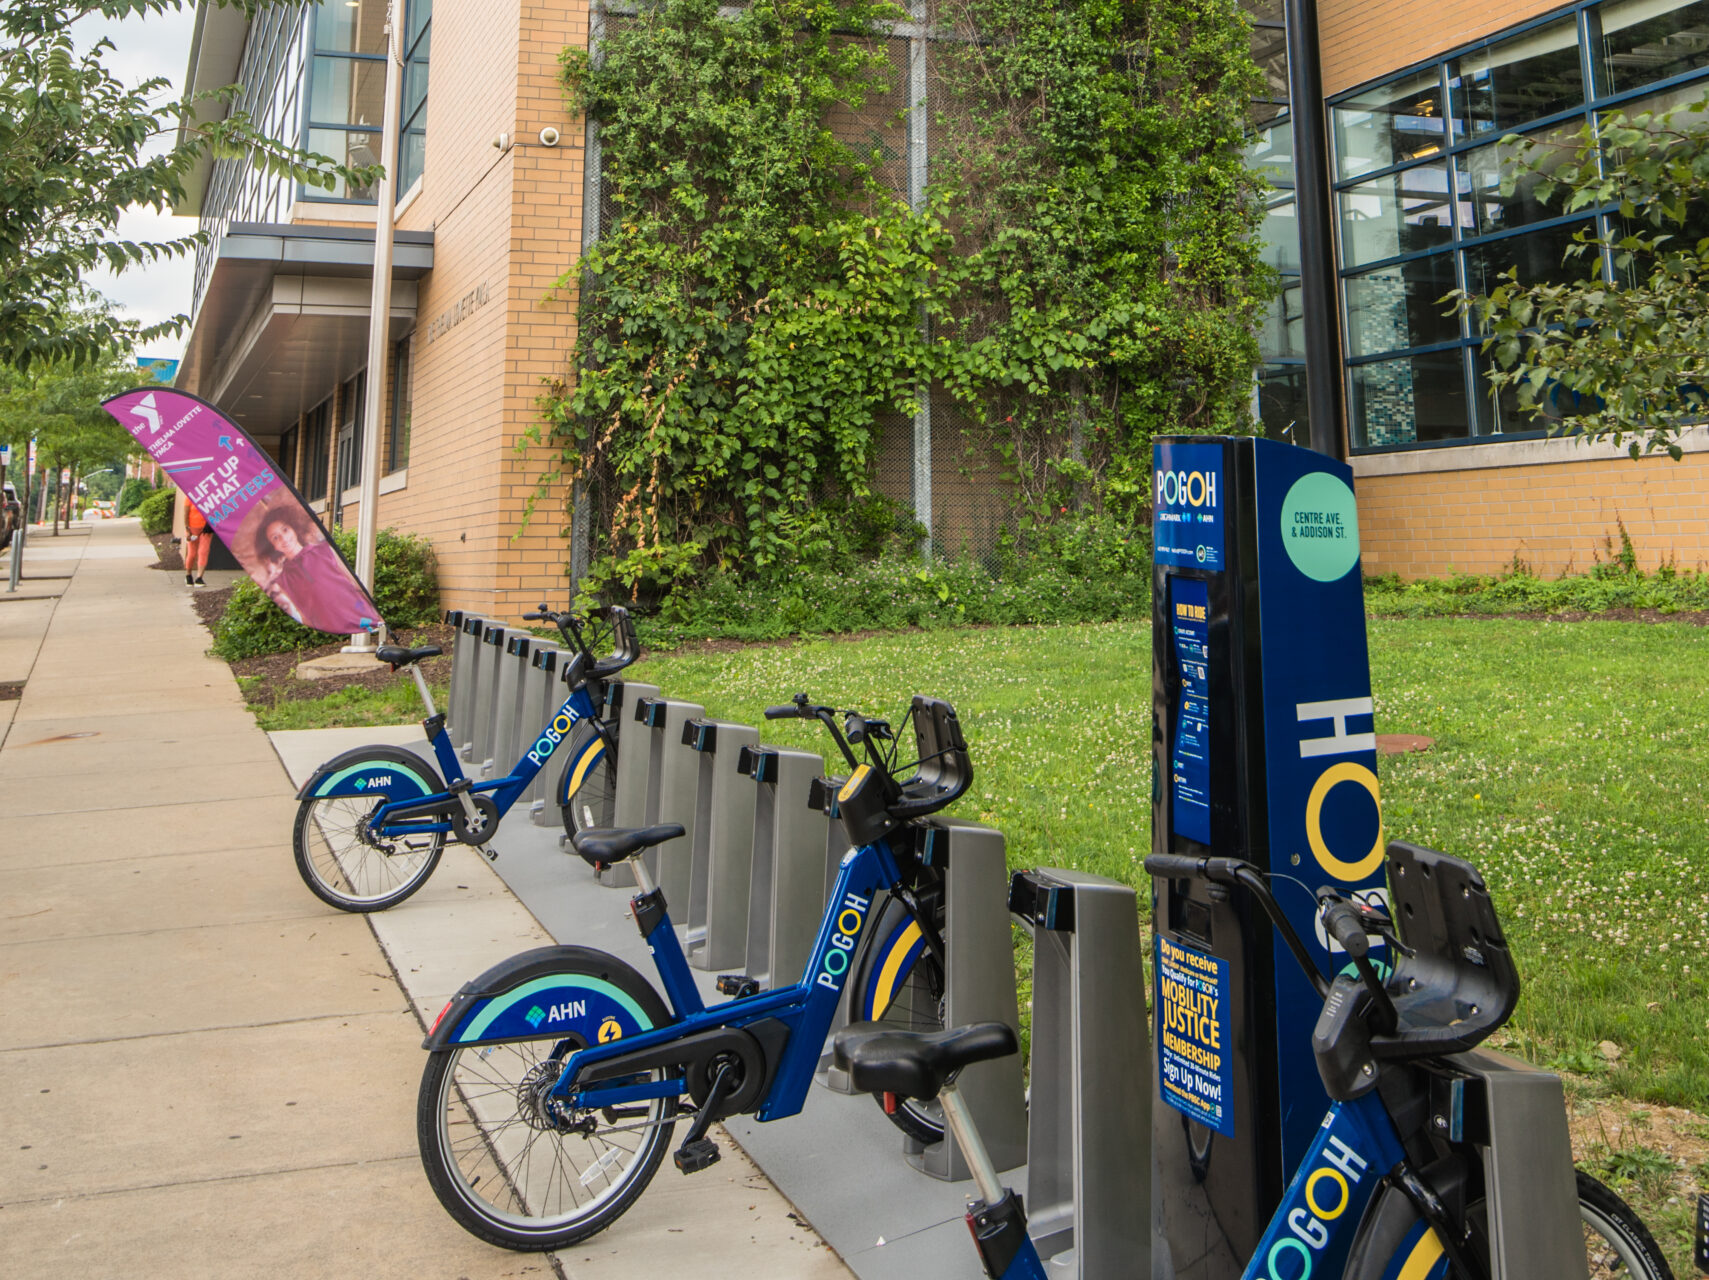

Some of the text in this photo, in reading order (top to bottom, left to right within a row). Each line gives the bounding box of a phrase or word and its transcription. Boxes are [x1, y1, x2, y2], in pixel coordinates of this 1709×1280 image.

[132, 422, 146, 435] the
[148, 428, 176, 452] THELMA
[173, 405, 203, 431] LOVETTE
[154, 440, 174, 458] YMCA
[188, 455, 240, 504] LIFT UP
[197, 474, 241, 514] WHAT
[207, 468, 275, 528] MATTERS
[1156, 470, 1217, 508] POGOH
[1291, 525, 1348, 539] & ADDISON ST.
[1294, 511, 1343, 525] CENTRE AVE.
[527, 704, 581, 768] POGOH
[367, 775, 392, 789] AHN
[816, 892, 870, 992] POGOH
[1161, 938, 1218, 975] Do you receive
[1162, 963, 1170, 977] You
[1170, 968, 1186, 987] Qualify
[1187, 975, 1195, 987] for
[547, 999, 586, 1023] AHN
[1161, 975, 1219, 1020] MOBILITY
[1162, 998, 1220, 1050] JUSTICE
[1163, 1029, 1221, 1072] MEMBERSHIP
[1163, 1056, 1222, 1102] Sign Up Now!
[1255, 1134, 1368, 1280] OGOH
